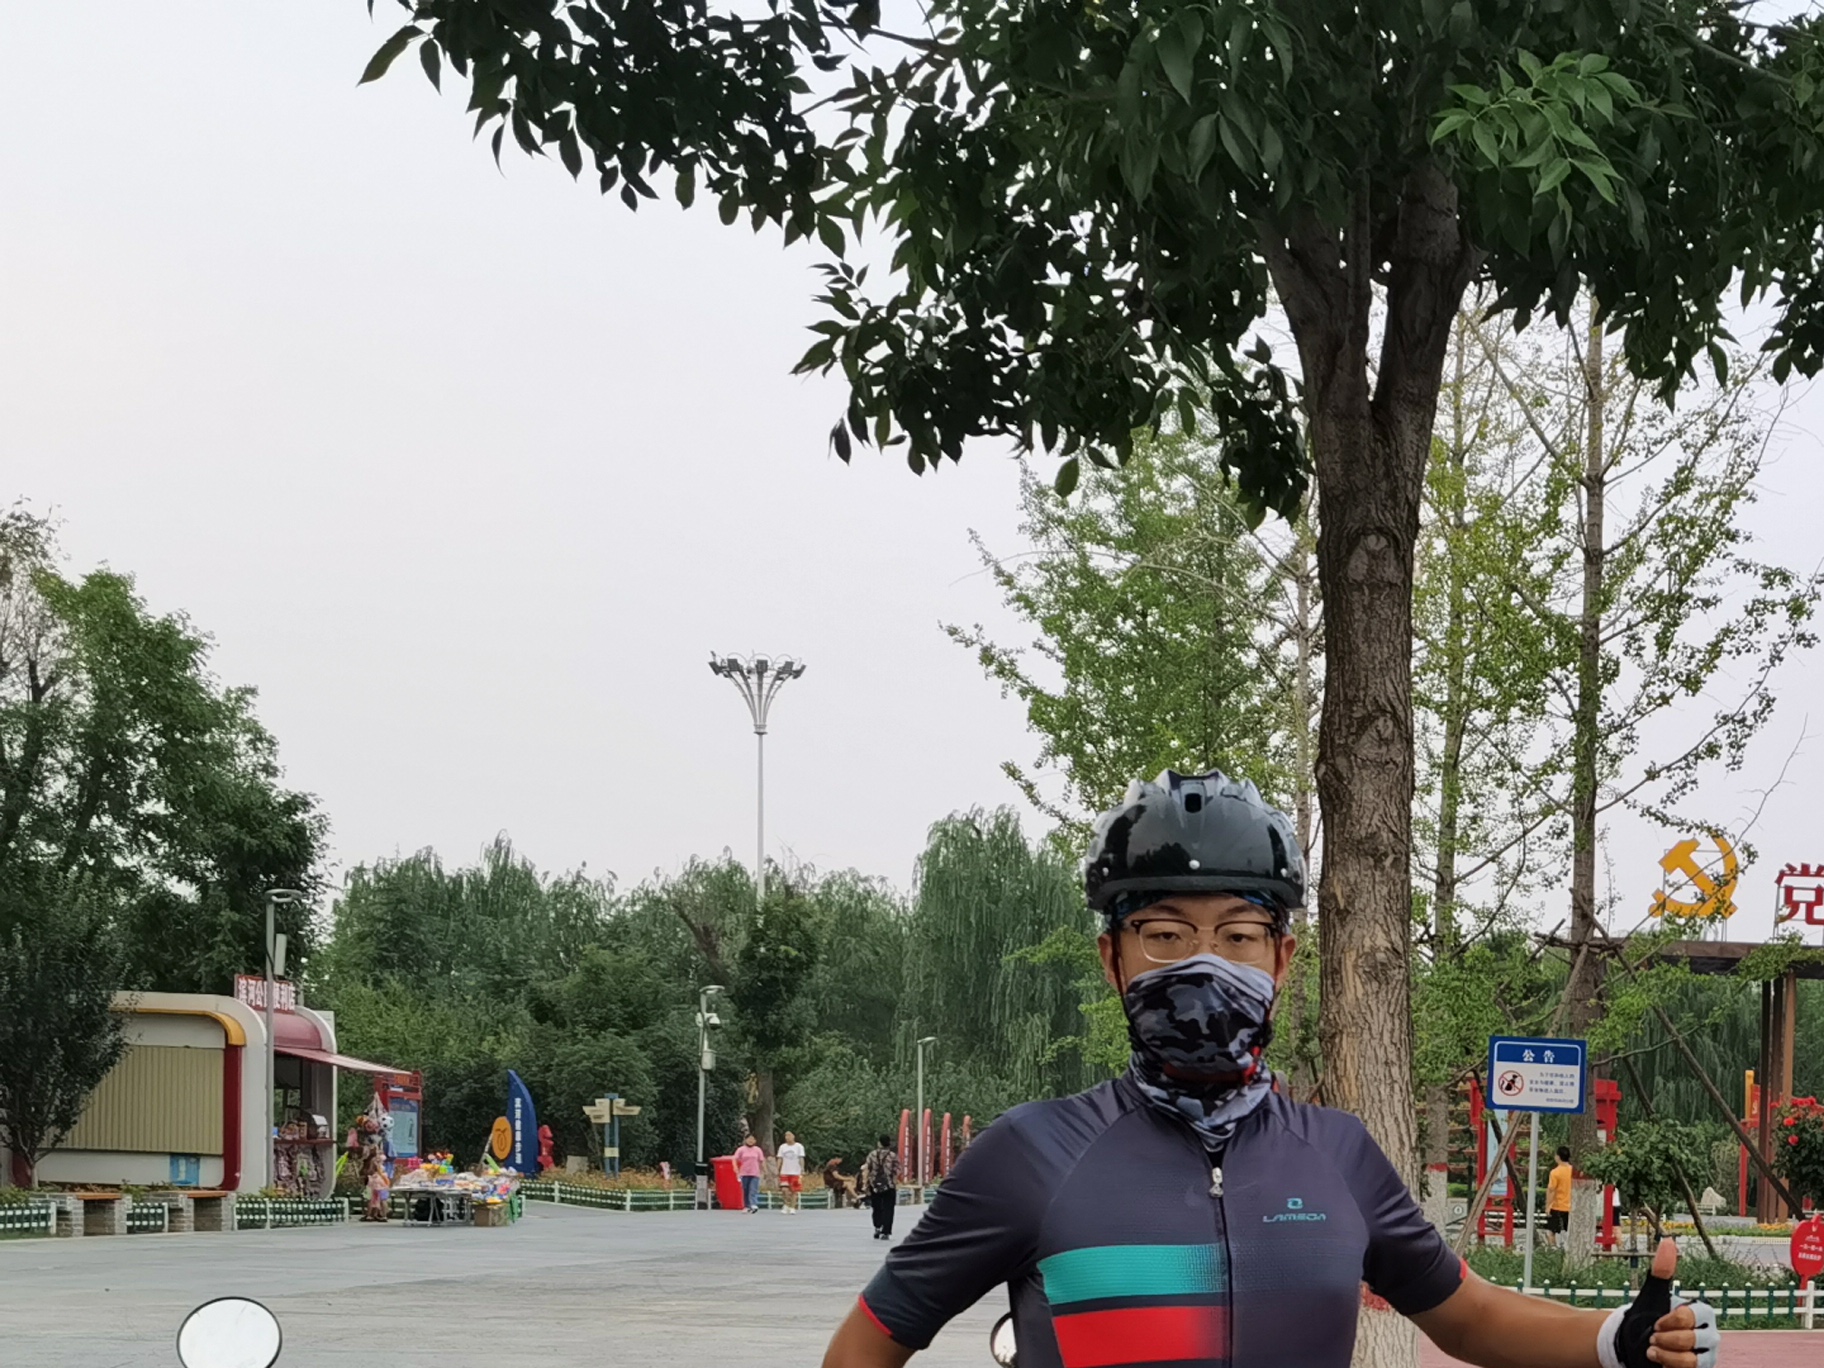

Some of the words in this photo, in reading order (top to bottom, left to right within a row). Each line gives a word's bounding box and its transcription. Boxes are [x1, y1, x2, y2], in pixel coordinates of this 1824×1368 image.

[238, 977, 296, 1011] 滨河公便利店
[1522, 1048, 1555, 1063] 公告
